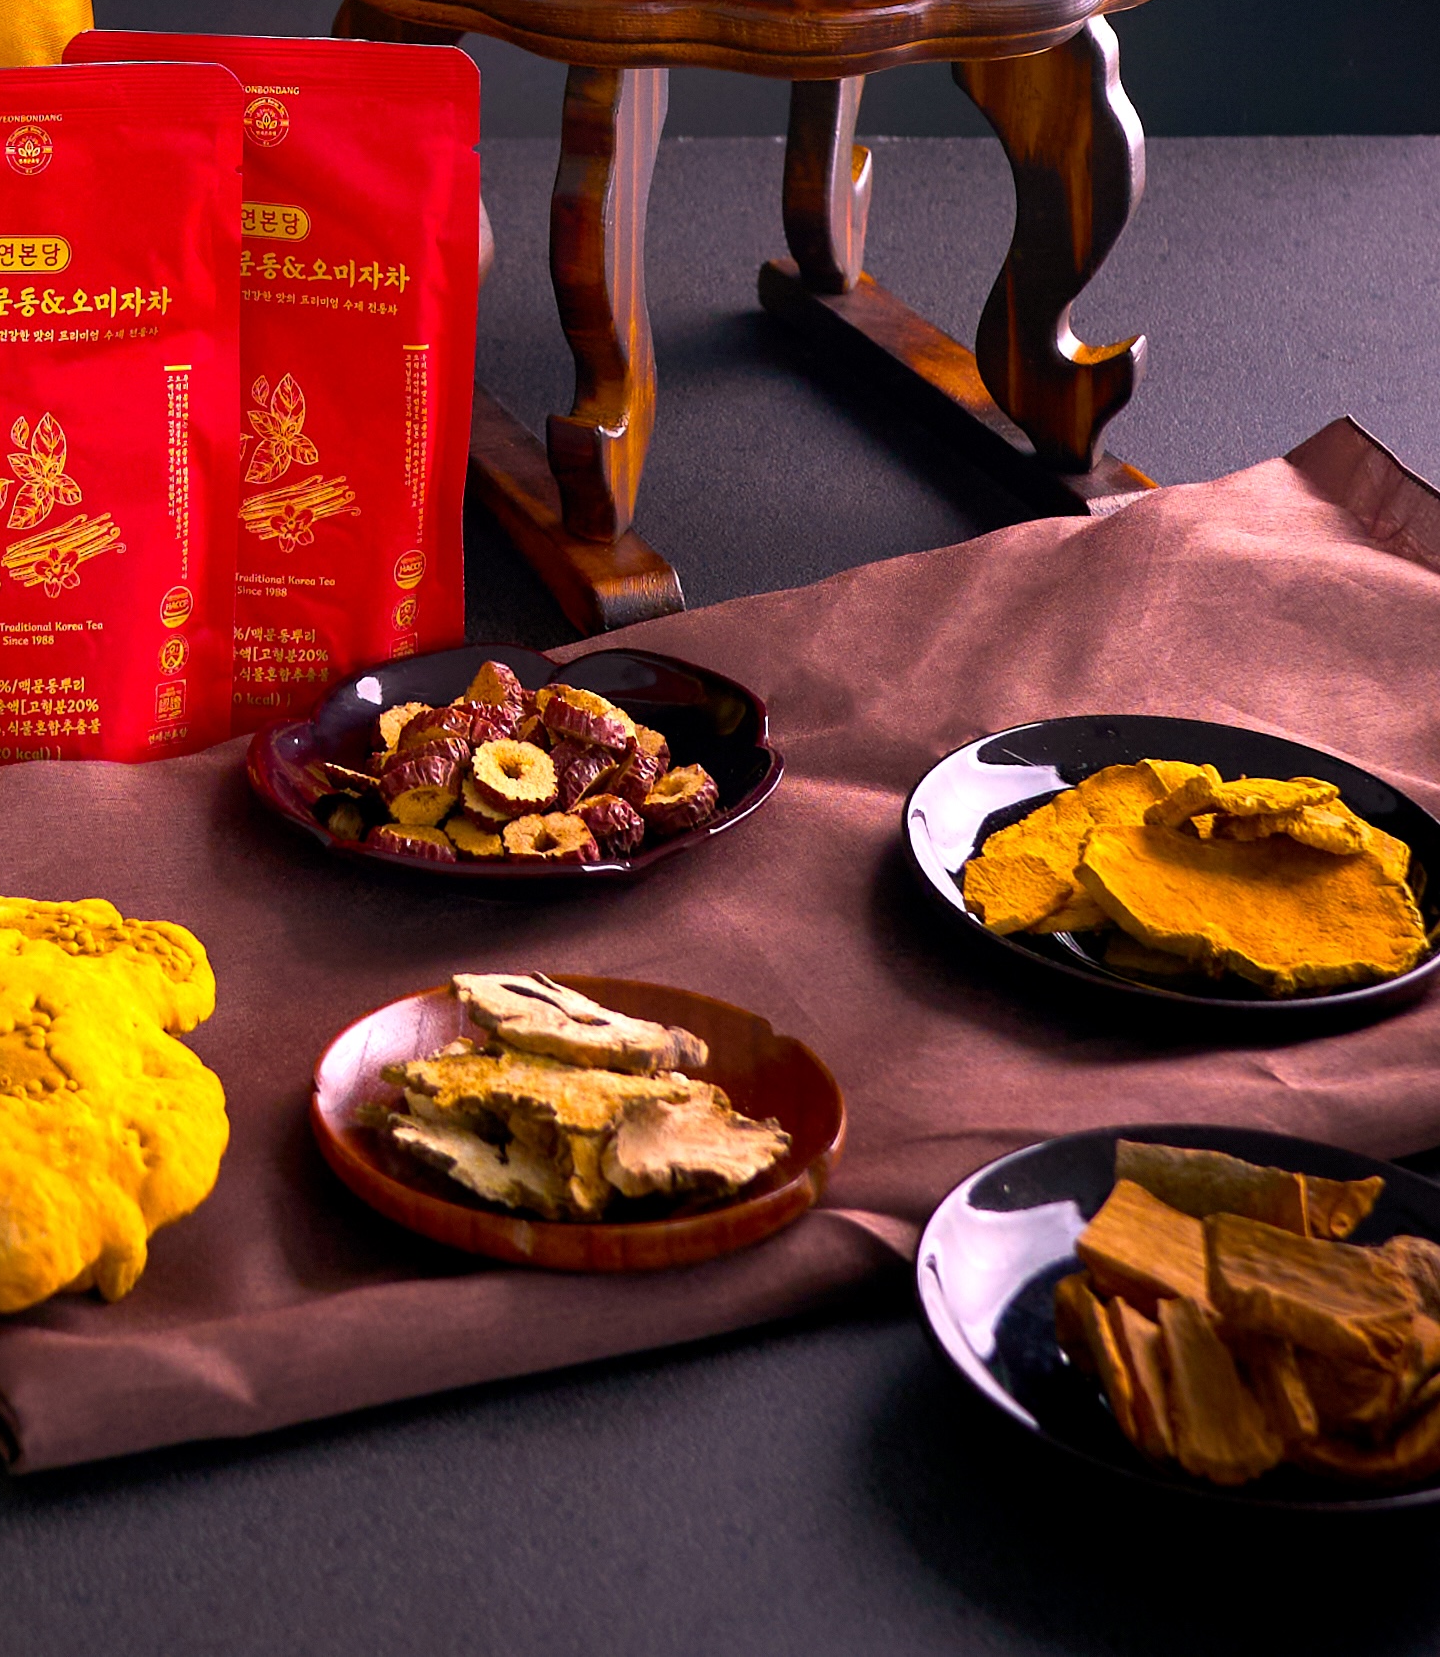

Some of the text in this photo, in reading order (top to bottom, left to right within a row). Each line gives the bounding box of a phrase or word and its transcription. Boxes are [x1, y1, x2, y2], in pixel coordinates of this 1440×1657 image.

[241, 208, 301, 236] 연본당
[299, 294, 339, 309] 프리미엄
[343, 299, 364, 312] 수제
[33, 329, 54, 343] 맛의
[58, 328, 100, 343] 프리미엄
[288, 575, 316, 586] Korea
[319, 576, 336, 586] Tea
[237, 586, 288, 597] Since 1988
[0, 621, 52, 632] Traditional
[55, 621, 83, 631] Korea
[86, 620, 104, 630] Tea
[2, 635, 55, 646] Since 1988
[15, 746, 51, 761] kcal)
